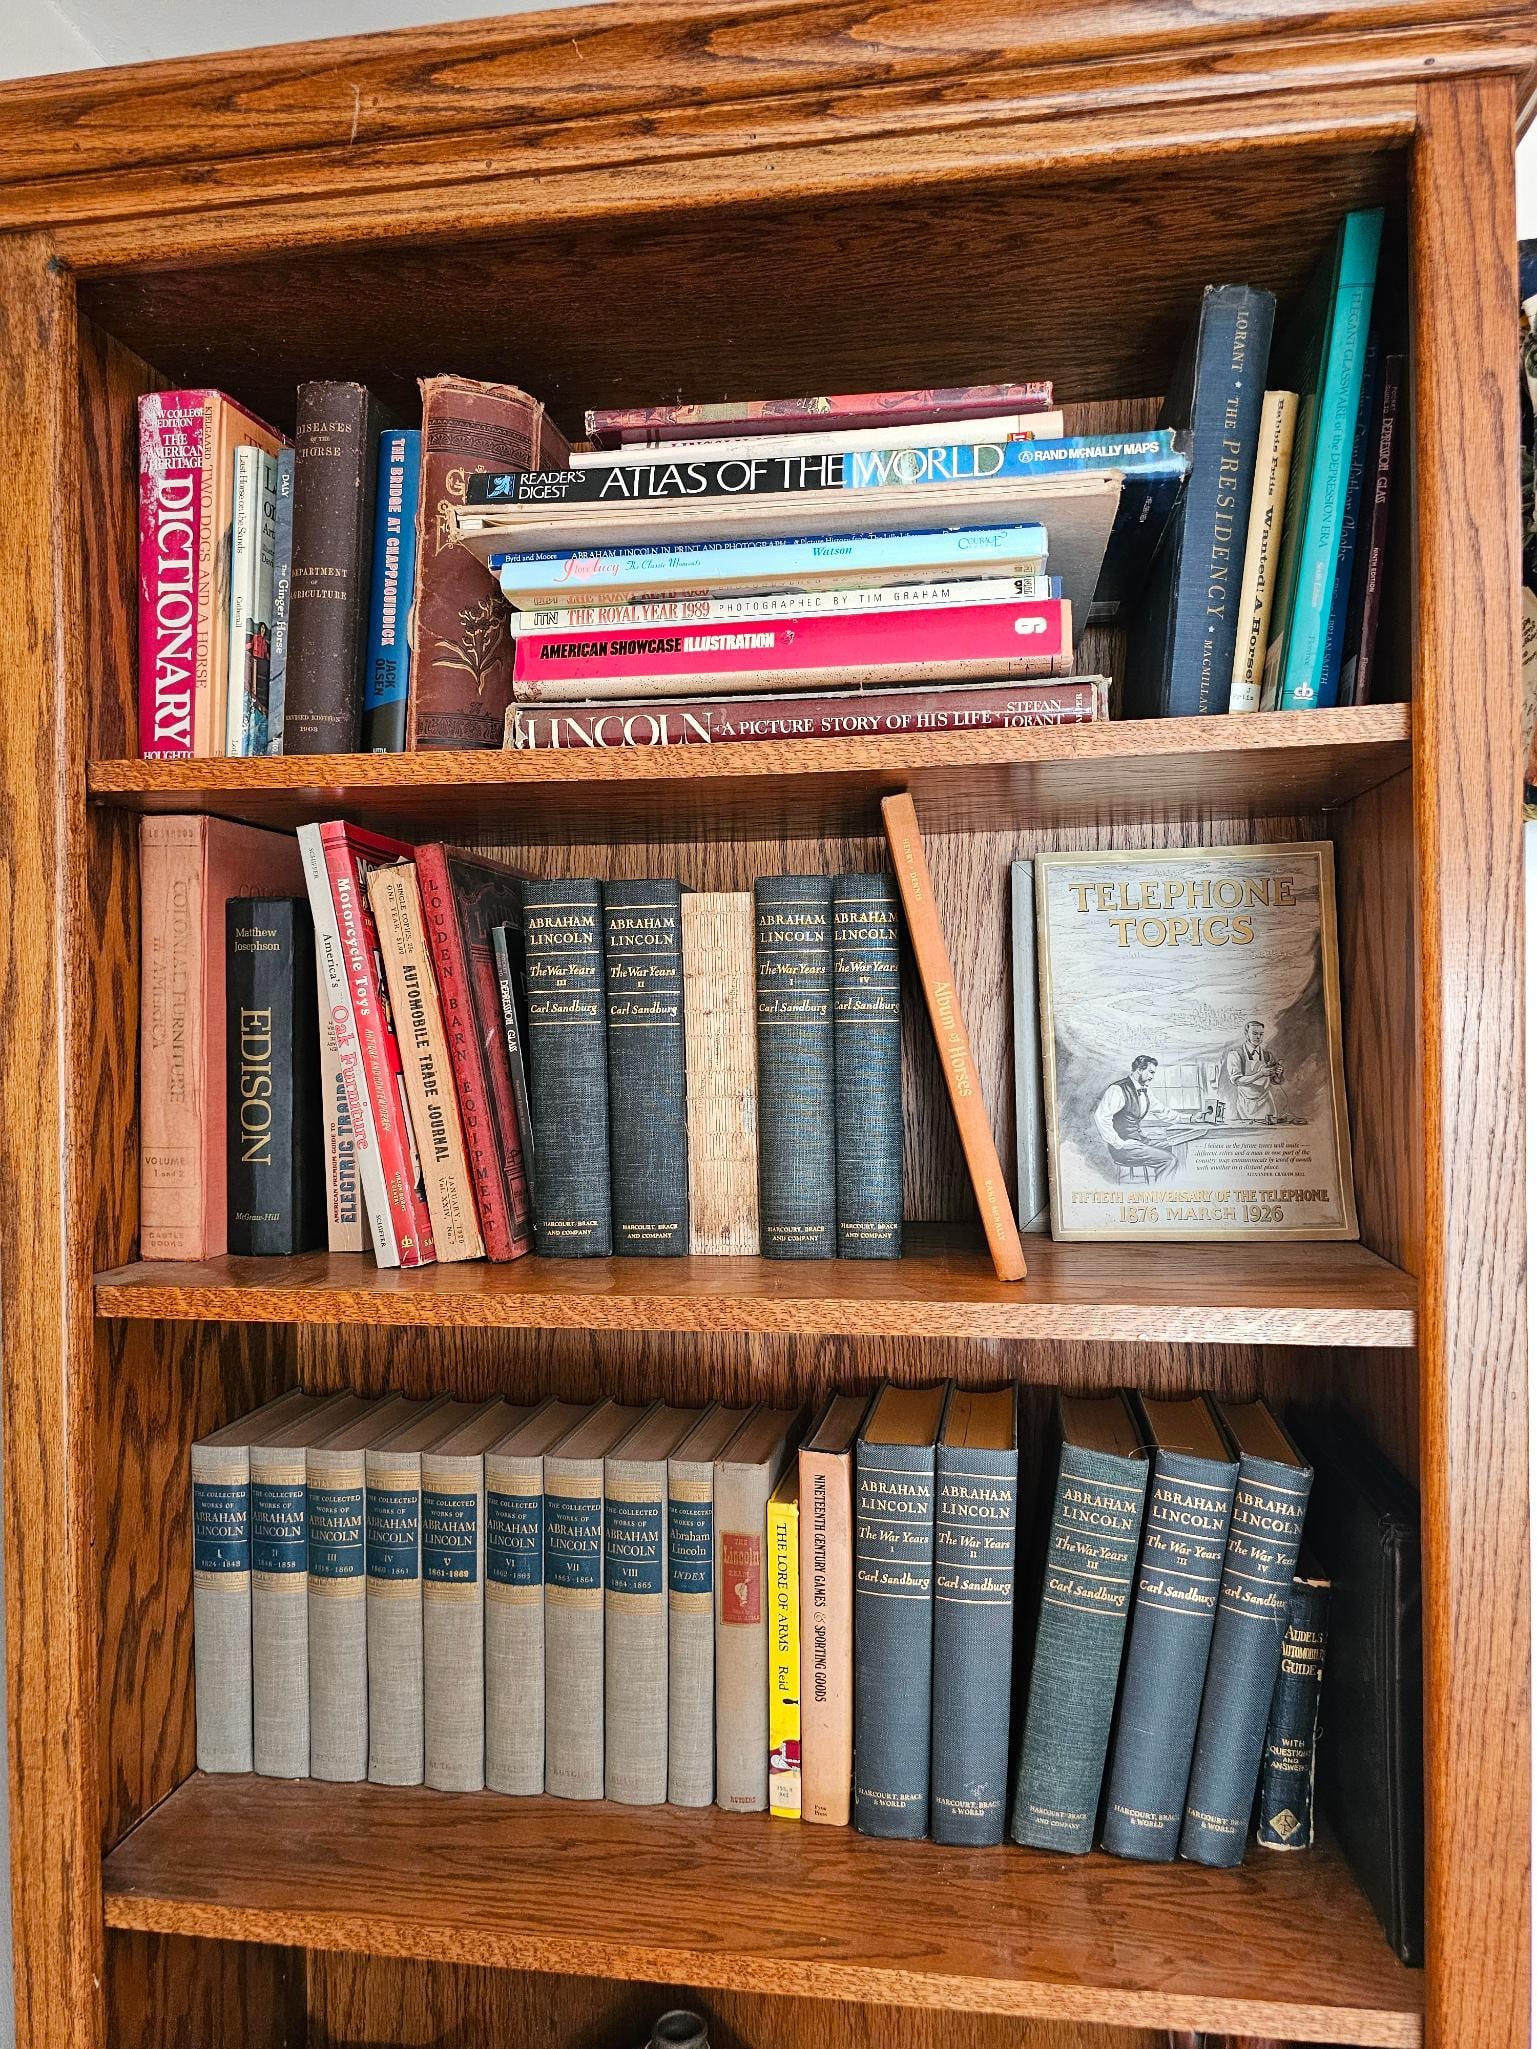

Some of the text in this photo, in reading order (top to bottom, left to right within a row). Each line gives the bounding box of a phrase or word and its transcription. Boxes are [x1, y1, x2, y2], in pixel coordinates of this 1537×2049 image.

[1345, 292, 1363, 345] ELEGANT
[1335, 348, 1354, 421] GLASSWARE
[297, 423, 352, 435] DISEASES
[302, 447, 341, 458] HORSE
[1034, 449, 1068, 461] RAND
[1123, 441, 1160, 455] MAPS
[1331, 435, 1344, 451] the
[1380, 417, 1393, 471] DEPRESSION
[240, 454, 248, 472] Last
[599, 443, 1005, 499] ATLAS OF THE WORLD
[201, 464, 213, 508] TWO
[239, 475, 247, 500] Horse
[281, 474, 290, 498] DALY
[520, 470, 586, 485] READER'S
[1322, 451, 1341, 524] DEPRESSION
[518, 485, 570, 499] DIGEST
[1375, 476, 1387, 504] GLASS
[1198, 310, 1250, 714] LORANT THE PRESIDENCY MACMILLAN
[199, 516, 212, 562] DOGS
[236, 527, 245, 554] Sands
[381, 438, 406, 646] THE BRIDGE AT CHAPPAQUIDDICK
[1318, 524, 1330, 549] ERA
[571, 543, 722, 560] ABRAHAM LINCOLN IN PRINT AND
[811, 546, 853, 557] Watson
[1256, 504, 1274, 594] Wanted!
[198, 569, 210, 607] AND
[274, 579, 289, 618] Ginger
[154, 474, 194, 748] DICTIONARY
[566, 609, 595, 625] THE
[598, 606, 640, 624] ROYAL
[641, 603, 678, 622] YEAR
[681, 601, 711, 618] 1989
[833, 595, 848, 606] BY
[859, 593, 882, 604] TIM
[893, 588, 950, 601] GRAHAM
[1253, 594, 1264, 614] A
[197, 613, 209, 624] A
[533, 611, 559, 626] ITN
[275, 621, 287, 655] Horse
[540, 632, 775, 660] AMERICAN SHOWCASE ILLUSTRATION
[1243, 616, 1262, 683] Horse!
[196, 632, 209, 688] HORSE
[374, 657, 385, 697] OLSEN
[384, 658, 396, 689] JACK
[1006, 699, 1062, 713] STEFAN
[524, 709, 993, 750] LINCOLN A PICTURE STORY OF HIS LIFE
[1003, 712, 1065, 728] LORANT
[1068, 876, 1298, 913] TELEPHONE
[235, 927, 278, 938] Matthew
[529, 916, 595, 929] ABRAHAM
[1109, 915, 1255, 948] TOPICS
[234, 940, 281, 952] Josephson
[337, 877, 371, 1017] Motorcycle Toys
[530, 932, 594, 945] LINCOLN
[322, 932, 340, 989] America's
[530, 963, 596, 976] The War Years
[499, 979, 514, 1026] DEPRESSION
[530, 1000, 598, 1016] Carl Sandburg
[331, 1004, 356, 1049] Oak
[932, 979, 957, 1032] Album
[947, 1043, 973, 1097] Horses
[506, 1028, 518, 1052] GLASS
[401, 964, 450, 1164] AUTOMOBILE TRADE JOURNAL
[427, 878, 497, 1233] LOUDEN BARN EQUIPMENT
[240, 1006, 272, 1166] EDISON
[340, 1051, 369, 1151] Furniture
[328, 1122, 340, 1224] AMERICAN PREMIUM GUIDE TO
[338, 1138, 358, 1224] ELECTRIC
[1071, 1189, 1330, 1204] FIFTIETH ANNIVERSARY OF THE TELEPHONE
[235, 1211, 280, 1221] McGraw-Hill
[1119, 1204, 1285, 1224] 1876 MARCH 1926
[941, 1486, 1013, 1502] ABRAHAM
[1062, 1488, 1137, 1514] ABRAHAM
[562, 1503, 601, 1511] COLLECTED
[942, 1502, 1011, 1519] LINCOLN
[1062, 1505, 1133, 1531] LINCOLN
[548, 1523, 601, 1537] ABRAHAM
[606, 1528, 659, 1542] ABRAHAM
[670, 1529, 710, 1541] Abraham
[938, 1531, 1010, 1549] The War Years
[550, 1537, 599, 1551] LINCOLN
[607, 1542, 656, 1557] LINCOLN
[671, 1543, 706, 1555] Lincoln
[723, 1545, 760, 1566] Lincoln
[567, 1563, 580, 1571] VII
[622, 1568, 638, 1577] VIII
[673, 1570, 706, 1581] INDEX
[814, 1474, 827, 1703] NINETEENTH CENTURY GAMES & SPORTING GOODS
[937, 1575, 1012, 1595] Carl Sandburg
[1049, 1578, 1126, 1607] Carl Sandburg
[776, 1523, 789, 1692] THE LORE OF ARMS Reid
[1284, 1624, 1324, 1644] AUDELS
[1281, 1659, 1317, 1676] GUIDE
[1281, 1738, 1305, 1747] WITH
